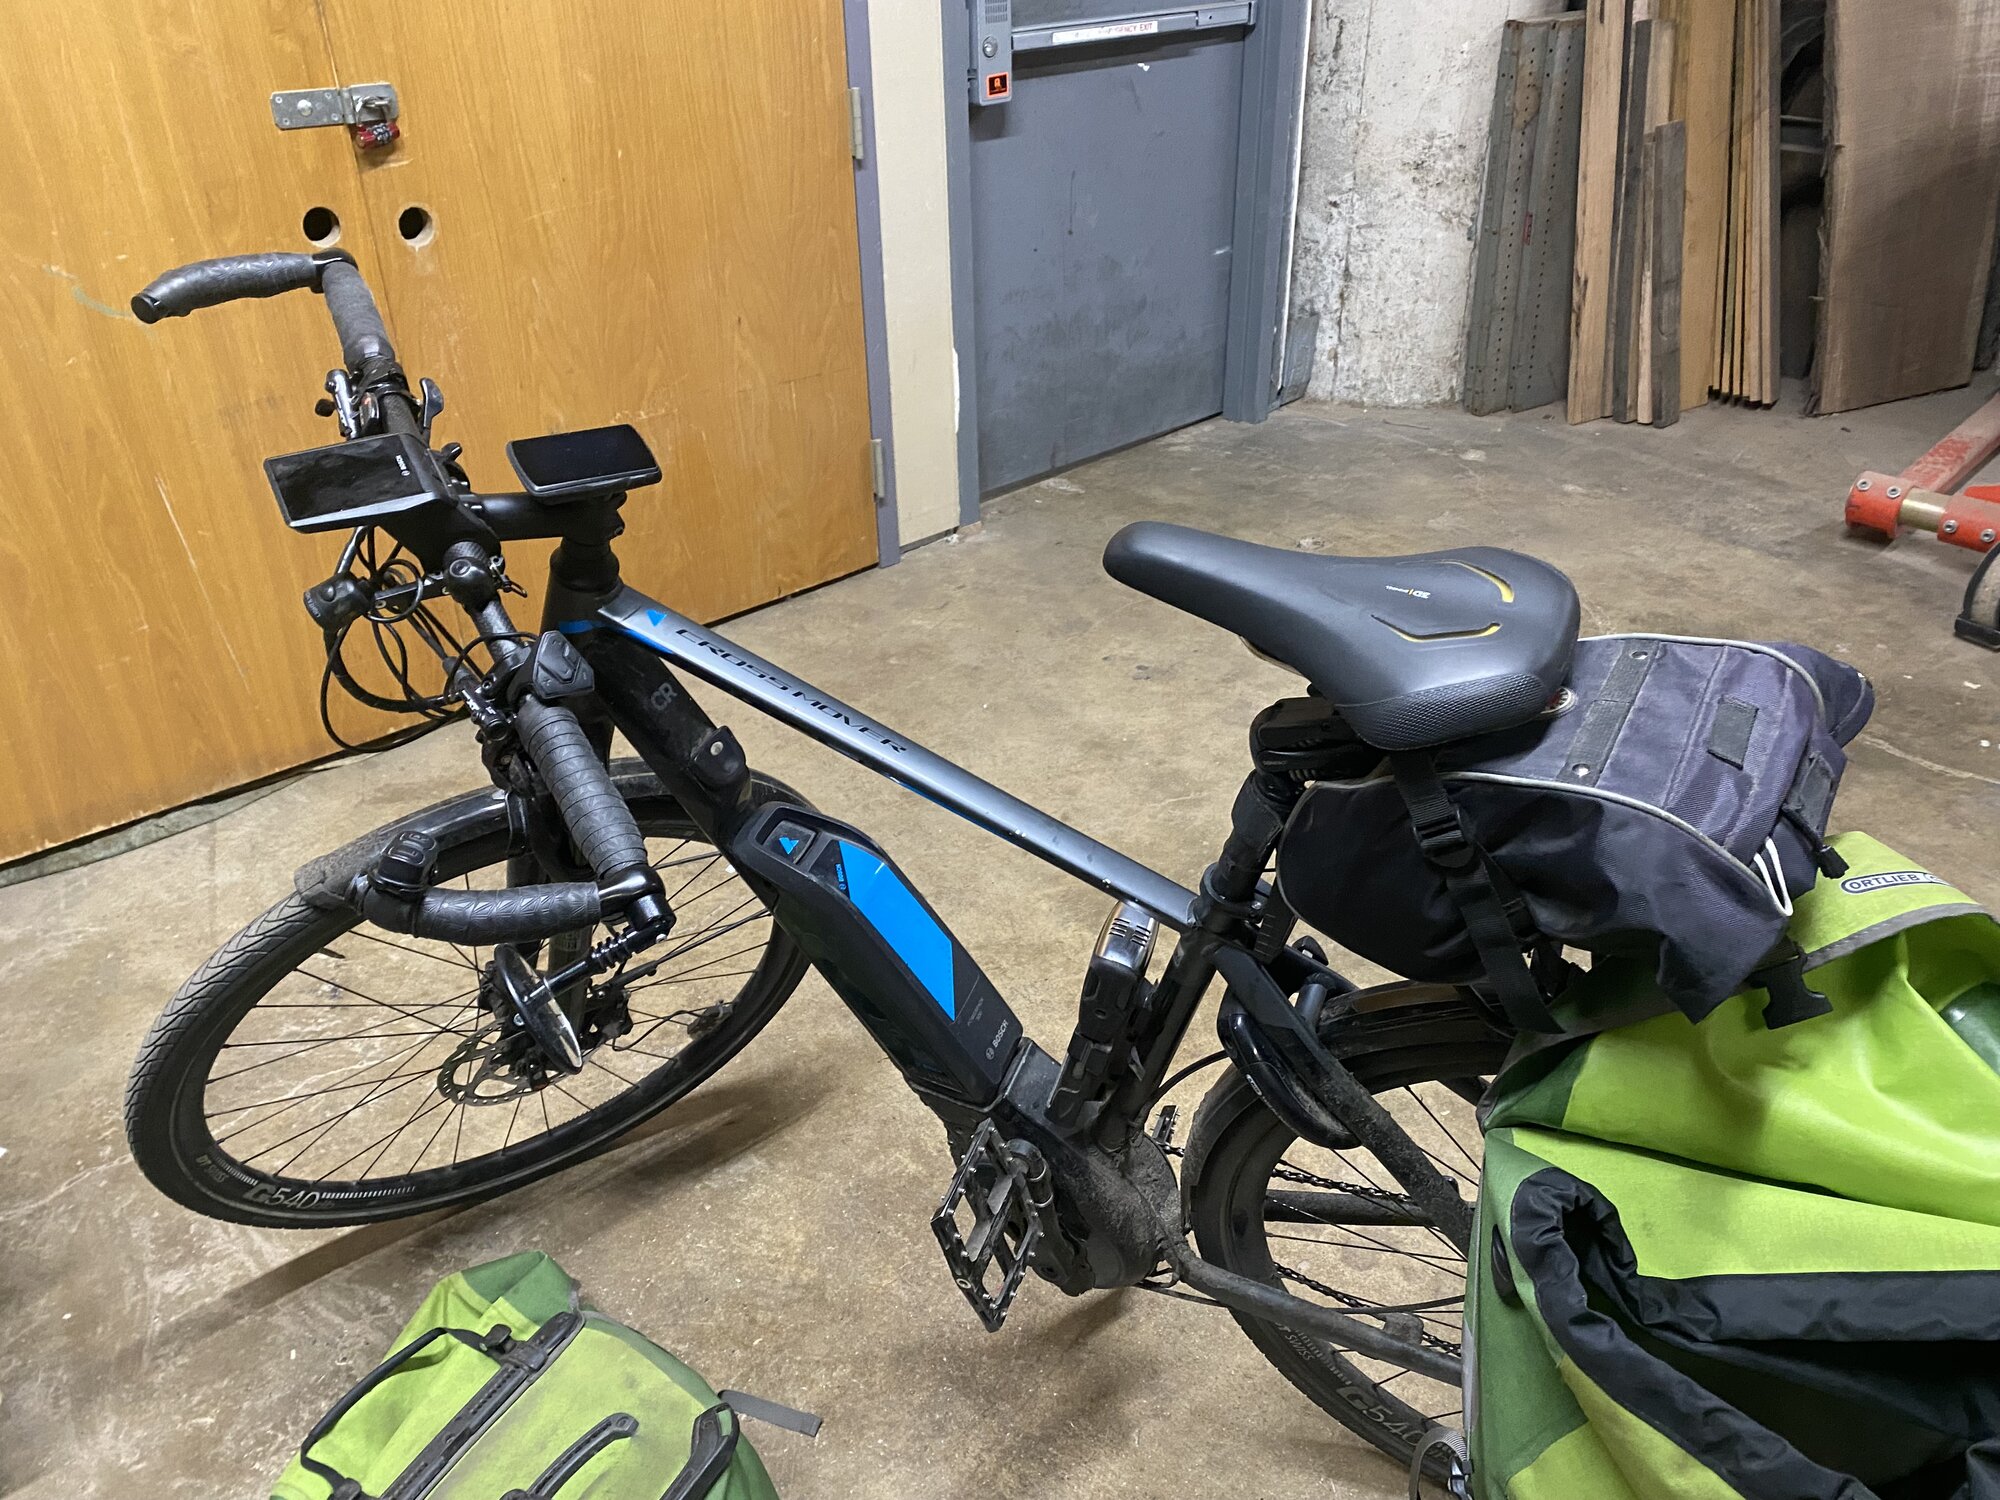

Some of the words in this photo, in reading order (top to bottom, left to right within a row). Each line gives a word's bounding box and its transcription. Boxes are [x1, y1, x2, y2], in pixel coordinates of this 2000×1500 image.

[1139, 22, 1153, 32] EXIT
[1849, 874, 1919, 889] ORTLIEB
[991, 1019, 1009, 1048] BOSCH
